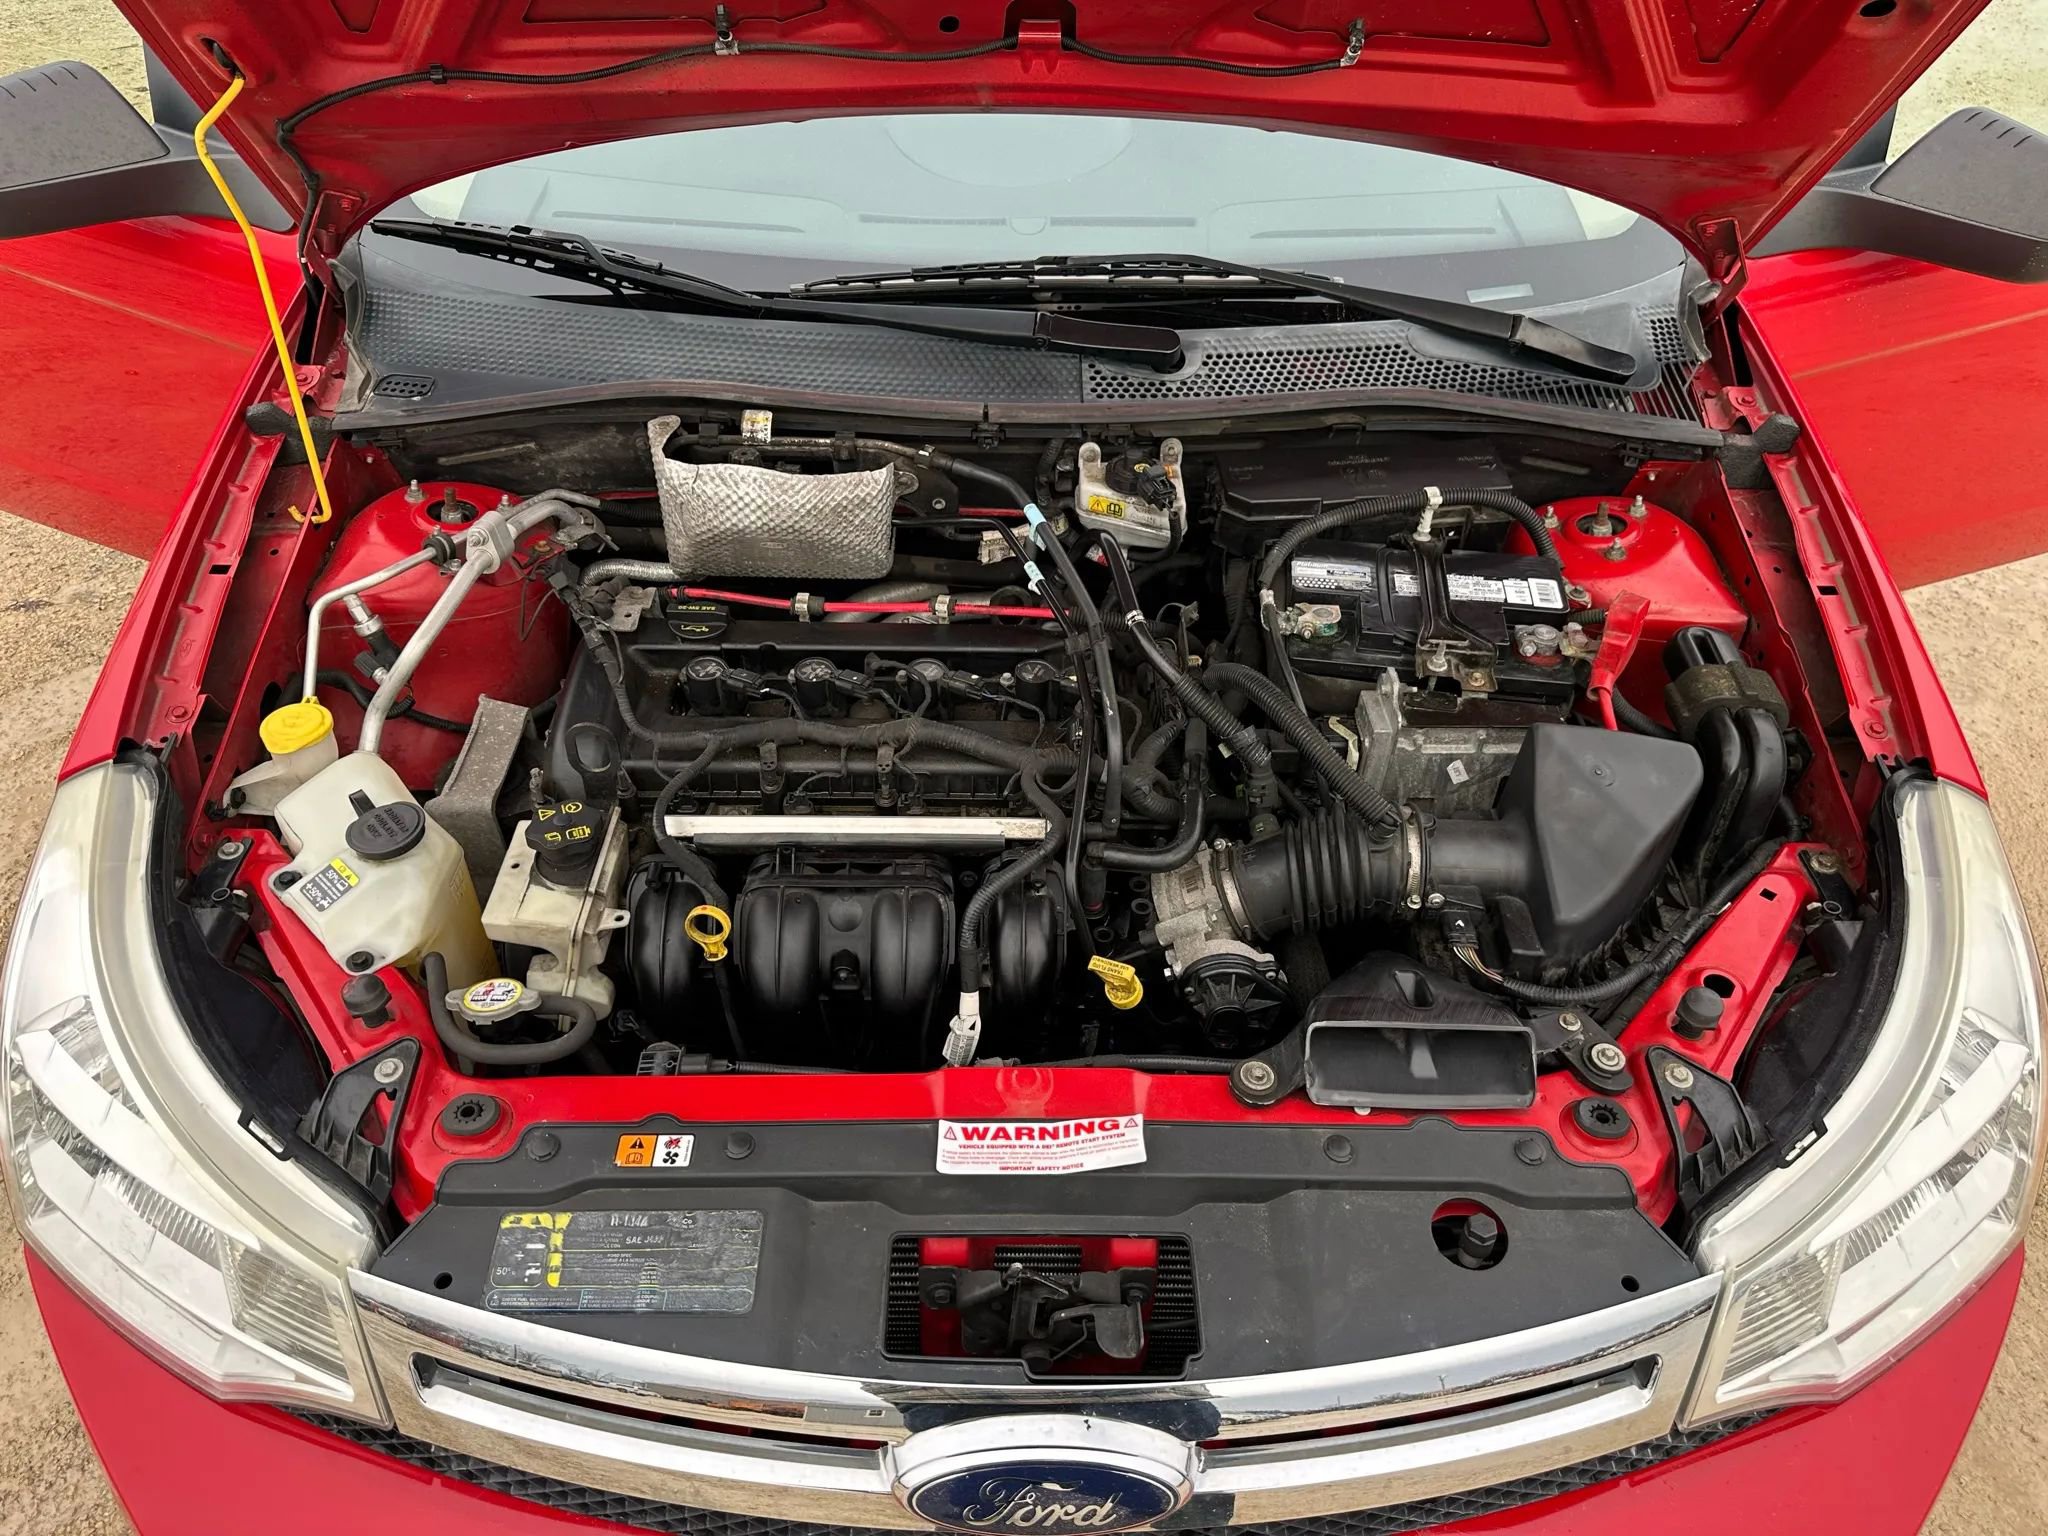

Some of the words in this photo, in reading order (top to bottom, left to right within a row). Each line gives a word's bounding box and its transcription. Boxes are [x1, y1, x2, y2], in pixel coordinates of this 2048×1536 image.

[961, 1119, 1120, 1141] WARNING
[1056, 1140, 1080, 1148] REMOTE
[1081, 1136, 1100, 1144] START
[1101, 1132, 1126, 1141] SYSTEM
[962, 1476, 1122, 1527] Ford
